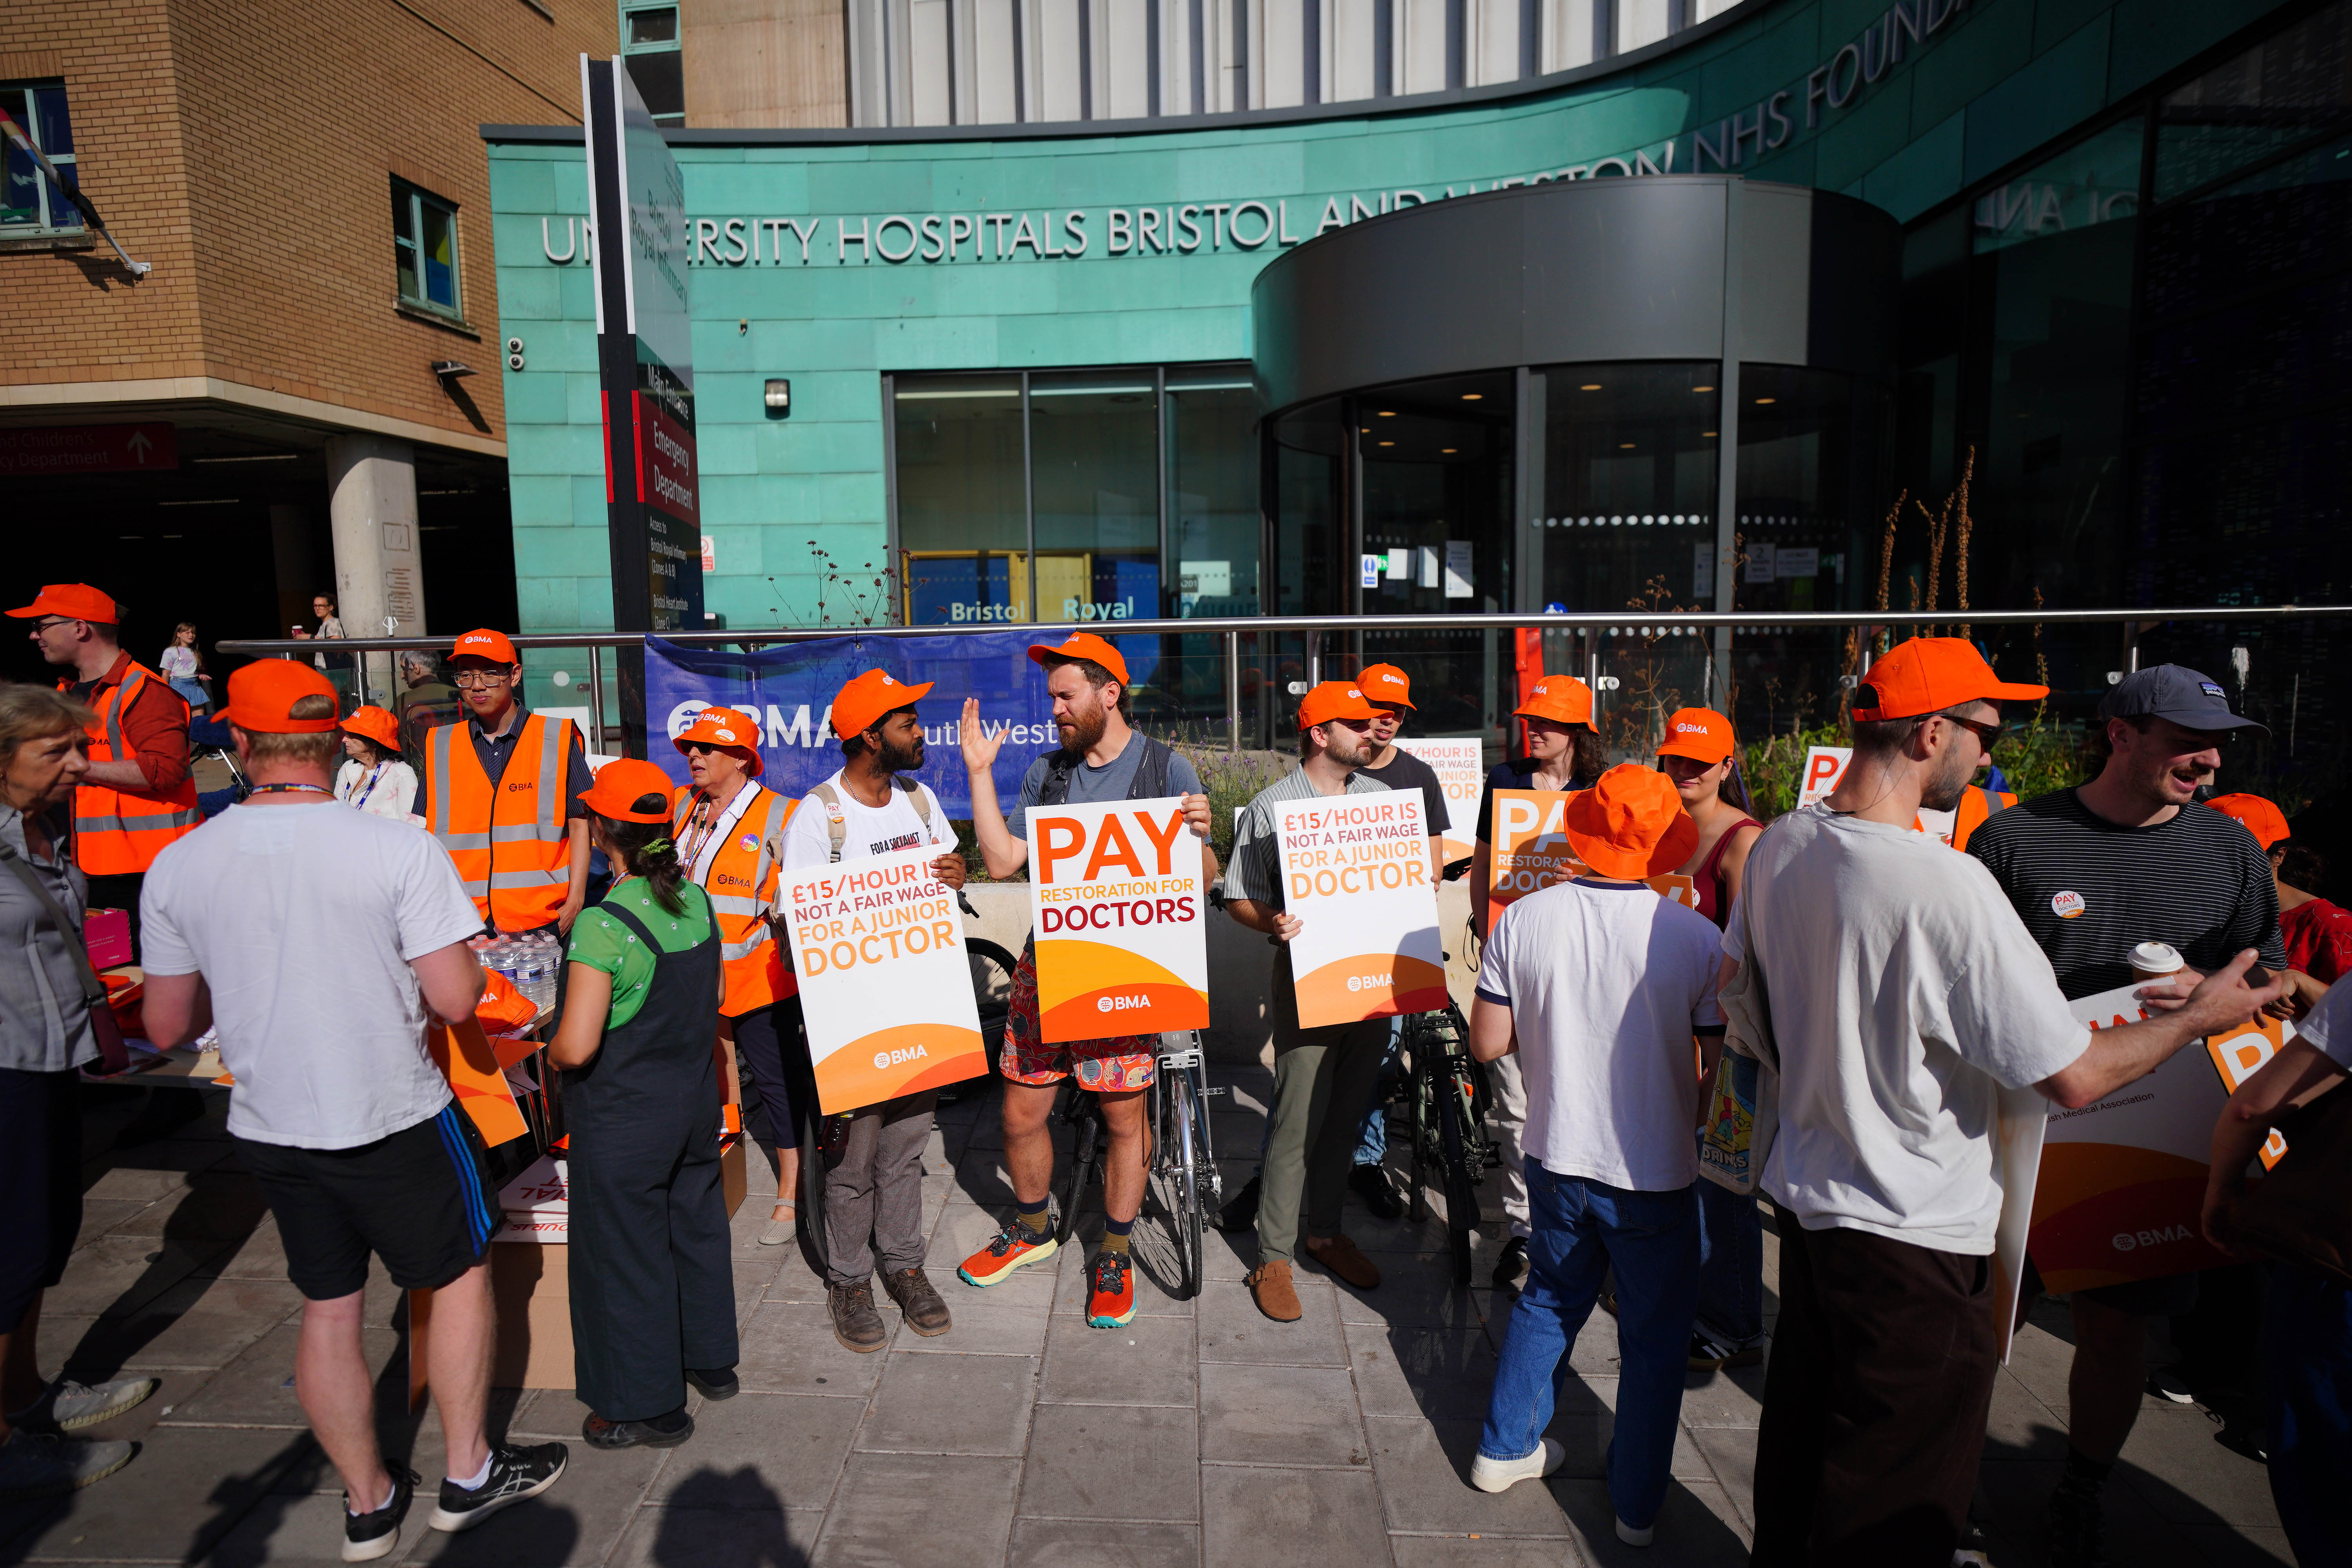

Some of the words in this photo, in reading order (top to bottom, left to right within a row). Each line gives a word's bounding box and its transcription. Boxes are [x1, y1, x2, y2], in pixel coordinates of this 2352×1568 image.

[838, 211, 1087, 263] HOSPITALS
[1108, 199, 1299, 255] BRISTOL
[1693, 91, 1793, 174] NHS
[1807, 0, 1969, 129] FOUND
[648, 188, 672, 248] Bristol
[631, 205, 655, 263] Royal
[657, 243, 688, 314] Infirmary
[648, 362, 665, 399] Main
[666, 378, 689, 420] Entrance
[21, 431, 94, 449] Children's
[653, 420, 689, 476] Emergency
[18, 449, 109, 470] Department
[654, 464, 693, 511] Department
[650, 515, 662, 532] Access
[662, 521, 667, 534] to
[651, 537, 663, 554] Bristol
[663, 543, 673, 559] Royal
[673, 544, 687, 564] Infirmary
[652, 558, 664, 575] (Zones
[665, 563, 668, 576] A
[668, 564, 672, 577] &
[672, 564, 676, 580] B)
[653, 593, 666, 609] Bristol
[666, 595, 676, 610] Heart
[676, 596, 688, 611] Institute
[951, 600, 1025, 622] Bristol
[1063, 596, 1134, 621] Royal
[655, 615, 666, 632] (Zone
[666, 615, 670, 632] C)
[473, 636, 492, 644] BMA
[1391, 675, 1405, 686] BMA
[703, 713, 726, 726] BMA
[981, 719, 1058, 744] West
[1686, 723, 1708, 735] BMA
[1448, 760, 1477, 769] WAGE
[1465, 747, 1476, 758] IS
[1285, 804, 1394, 832] £15/HOUR
[1399, 802, 1418, 820] IS
[870, 841, 885, 855] FOR
[884, 840, 890, 852] A
[889, 831, 920, 850] SOCIALIST
[1036, 808, 1185, 884] PAY
[1286, 833, 1319, 849] NOT
[1323, 831, 1335, 845] A
[1338, 828, 1373, 844] FAIR
[1375, 823, 1420, 840] WAGE
[1288, 849, 1329, 870] FOR
[1334, 848, 1348, 865] A
[1351, 840, 1422, 866] JUNIOR
[728, 876, 751, 889] BMA
[792, 864, 918, 904] £15/HOUR
[1040, 881, 1157, 903] RESTORATION
[1161, 878, 1194, 893] FOR
[1290, 860, 1426, 900] DOCTOR
[795, 902, 833, 923] NOT
[838, 900, 851, 915] A
[855, 891, 893, 911] FAIR
[897, 881, 947, 902] WAGE
[2054, 893, 2075, 905] PAY
[798, 920, 846, 945] FOR
[851, 916, 867, 935] A
[871, 899, 951, 934] JUNIOR
[1042, 896, 1196, 933] DOCTORS
[801, 920, 957, 978] DOCTOR
[1362, 973, 1396, 989] BMA
[479, 992, 498, 1006] MA
[1115, 995, 1151, 1010] BMA
[891, 1044, 928, 1065] BMA
[2062, 1105, 2099, 1119] Medical
[2100, 1093, 2155, 1110] Association
[2136, 1224, 2194, 1248] BMA
